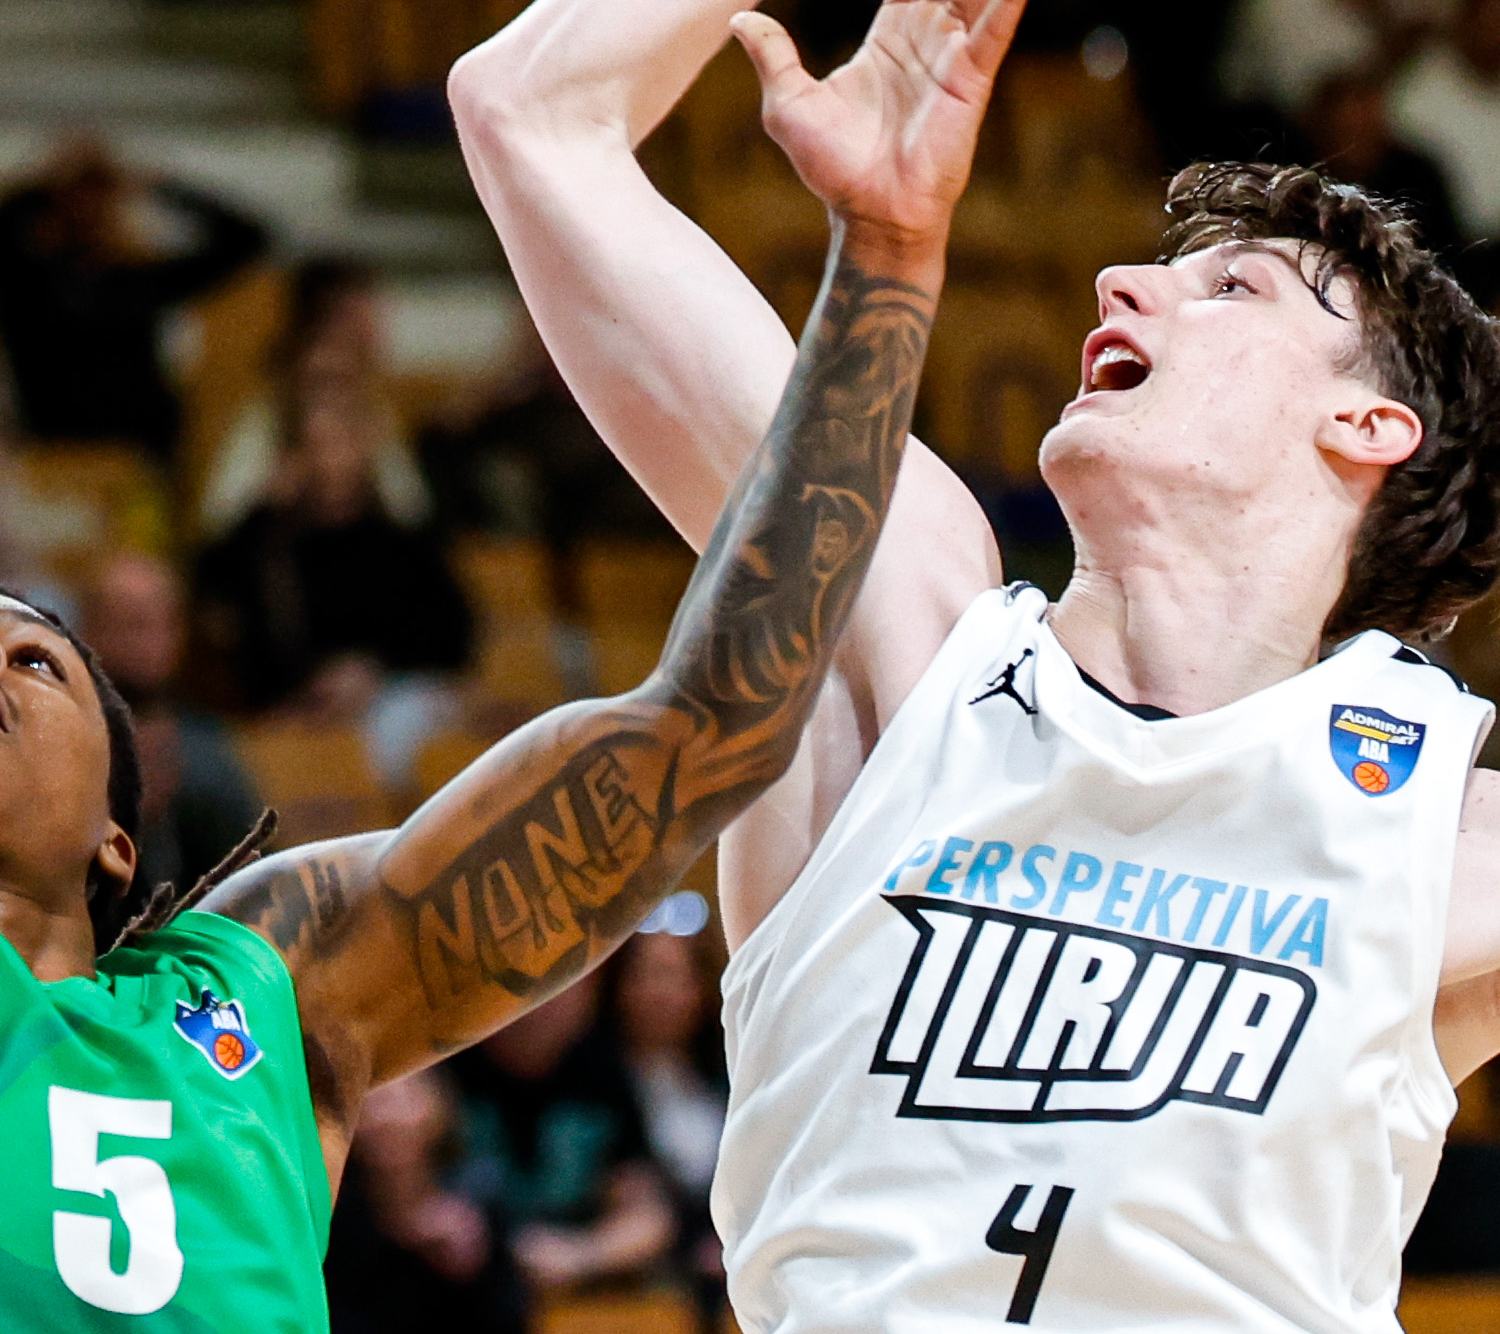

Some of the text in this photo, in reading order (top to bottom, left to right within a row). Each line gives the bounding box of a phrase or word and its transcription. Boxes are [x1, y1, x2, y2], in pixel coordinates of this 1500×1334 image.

[1339, 708, 1420, 737] ADMIRAL
[1357, 737, 1390, 764] ABA
[882, 836, 1330, 968] PERSPEKTIVA
[47, 1085, 185, 1316] 5
[984, 1183, 1076, 1325] 4
